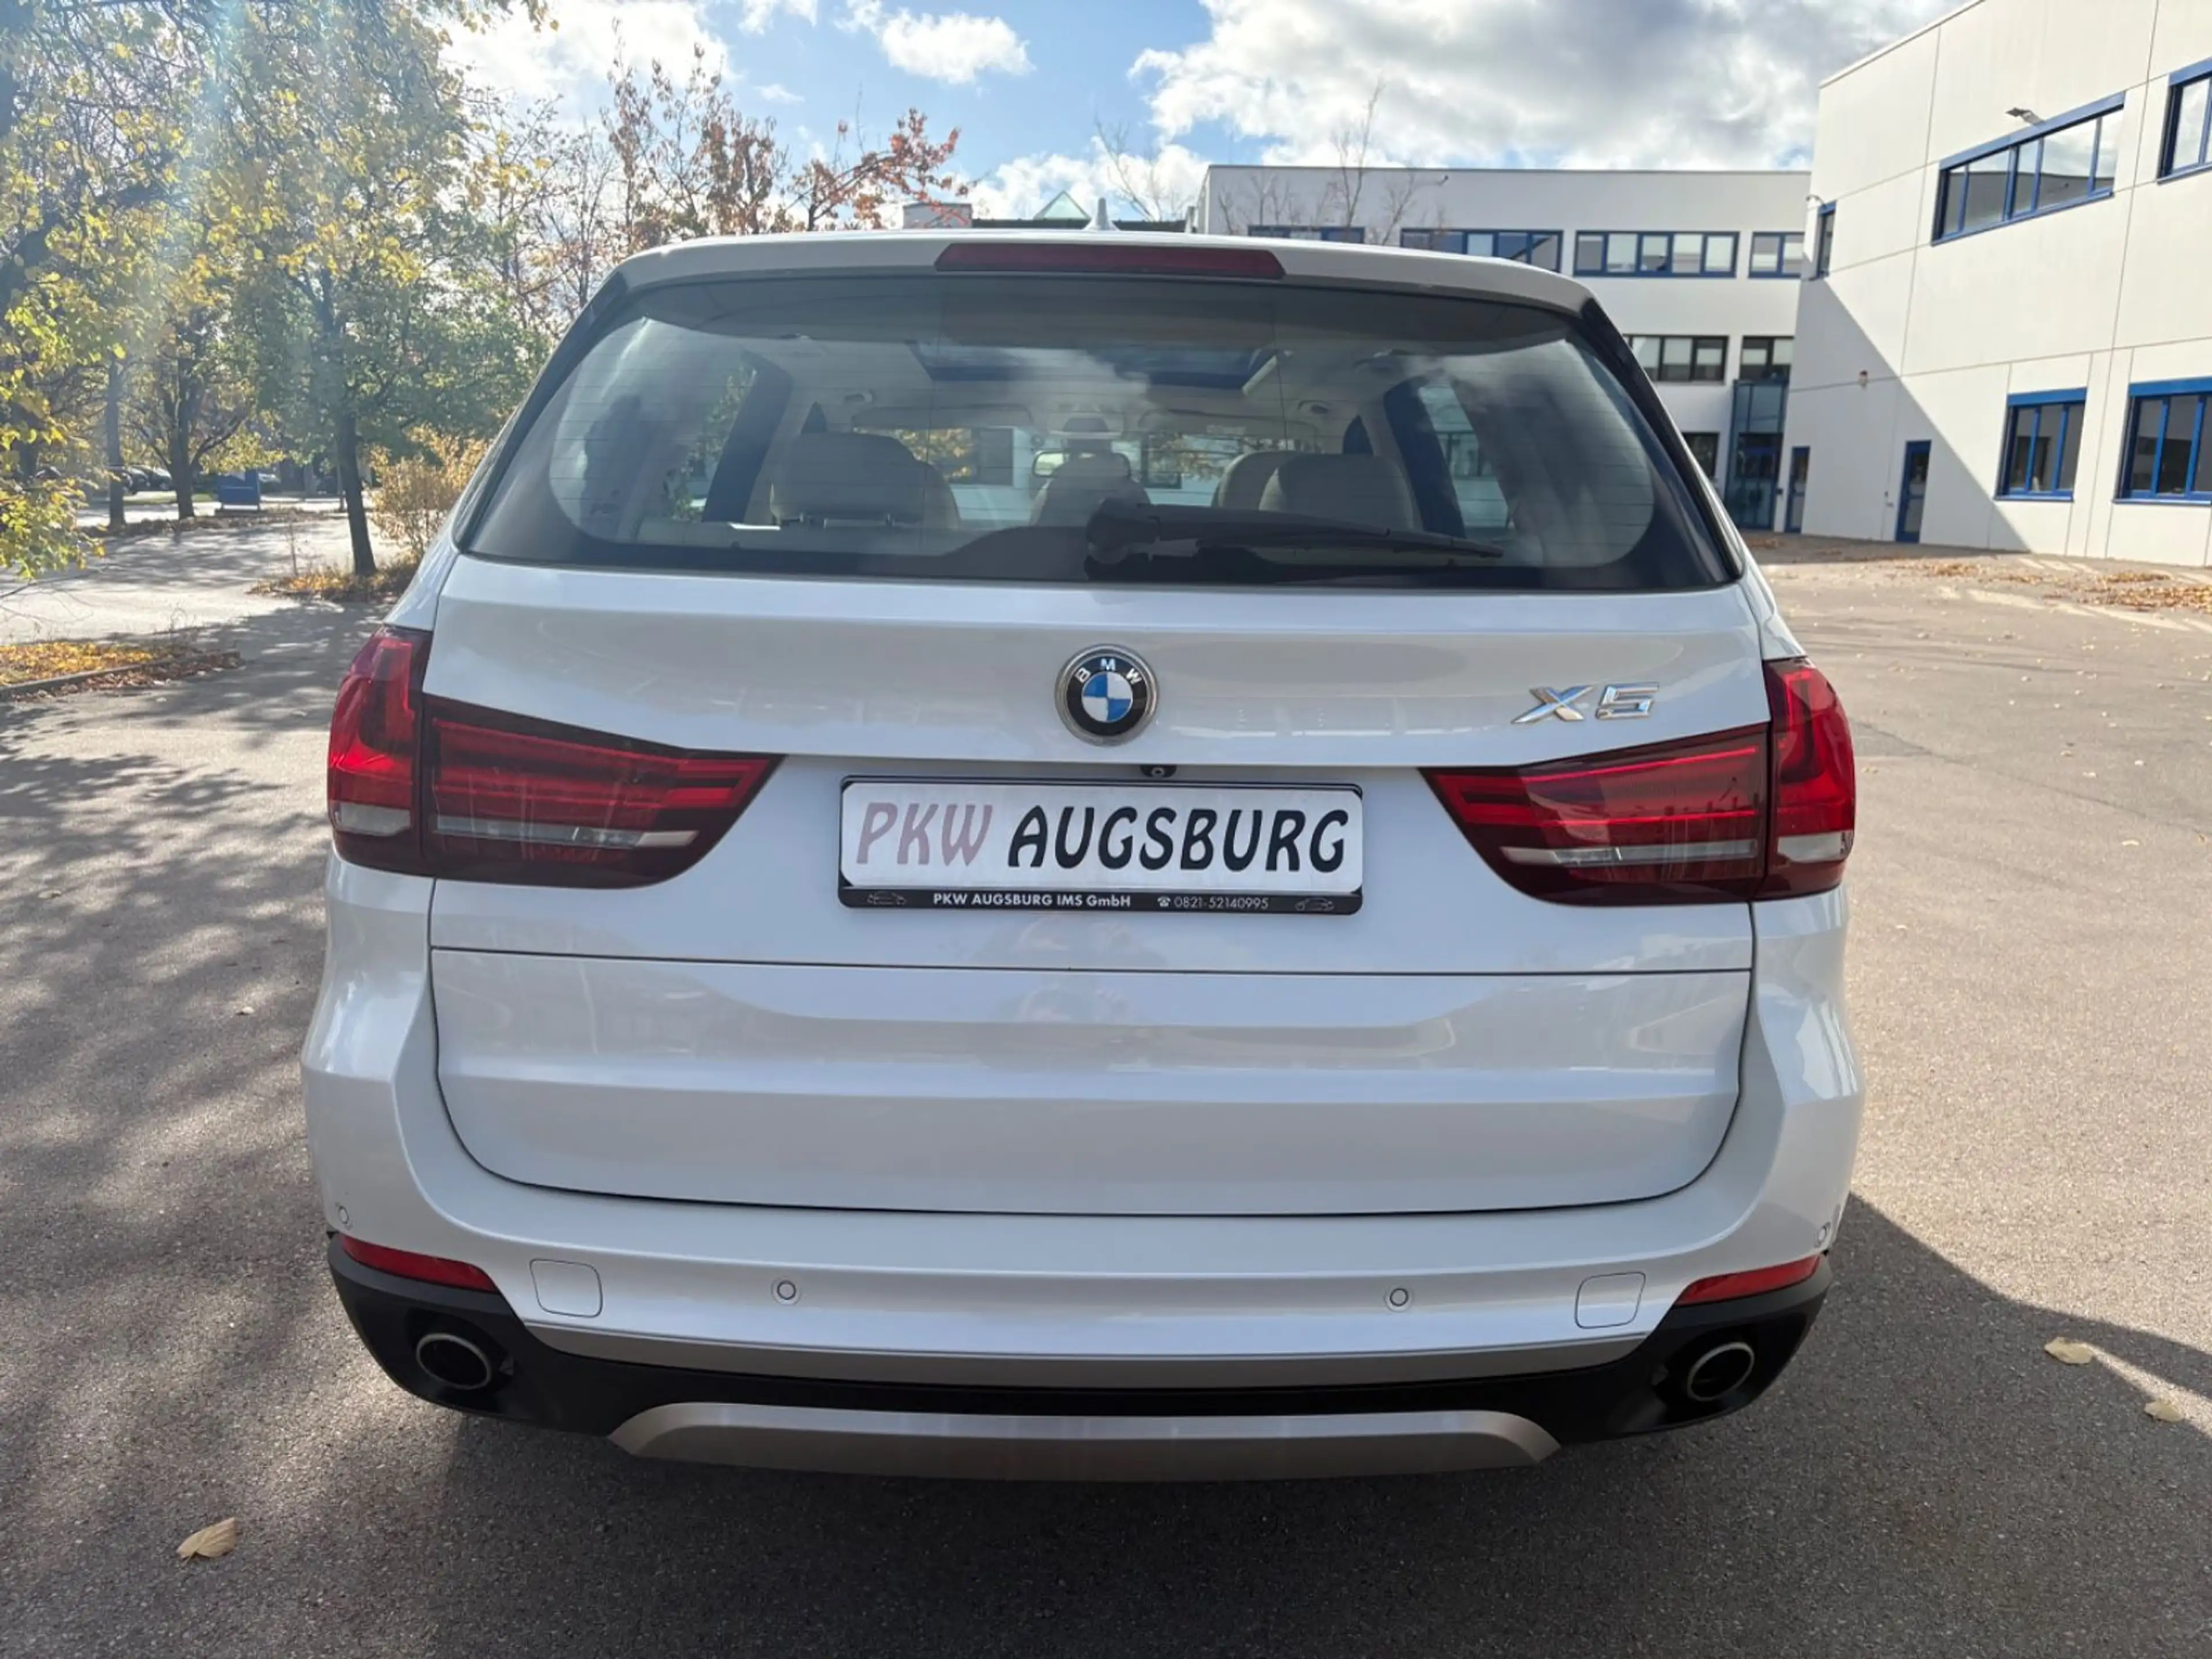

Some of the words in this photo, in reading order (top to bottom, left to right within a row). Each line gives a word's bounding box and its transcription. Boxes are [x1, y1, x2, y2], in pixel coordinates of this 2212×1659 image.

[1074, 658, 1142, 684] BMW
[1510, 681, 1660, 724] X5
[857, 802, 993, 866] PKW
[1007, 805, 1349, 873] AUGSBURG
[933, 892, 968, 905] PKW
[971, 893, 1053, 906] AUGSBURG
[1056, 894, 1083, 907] IMS
[1086, 894, 1131, 908] GmbH
